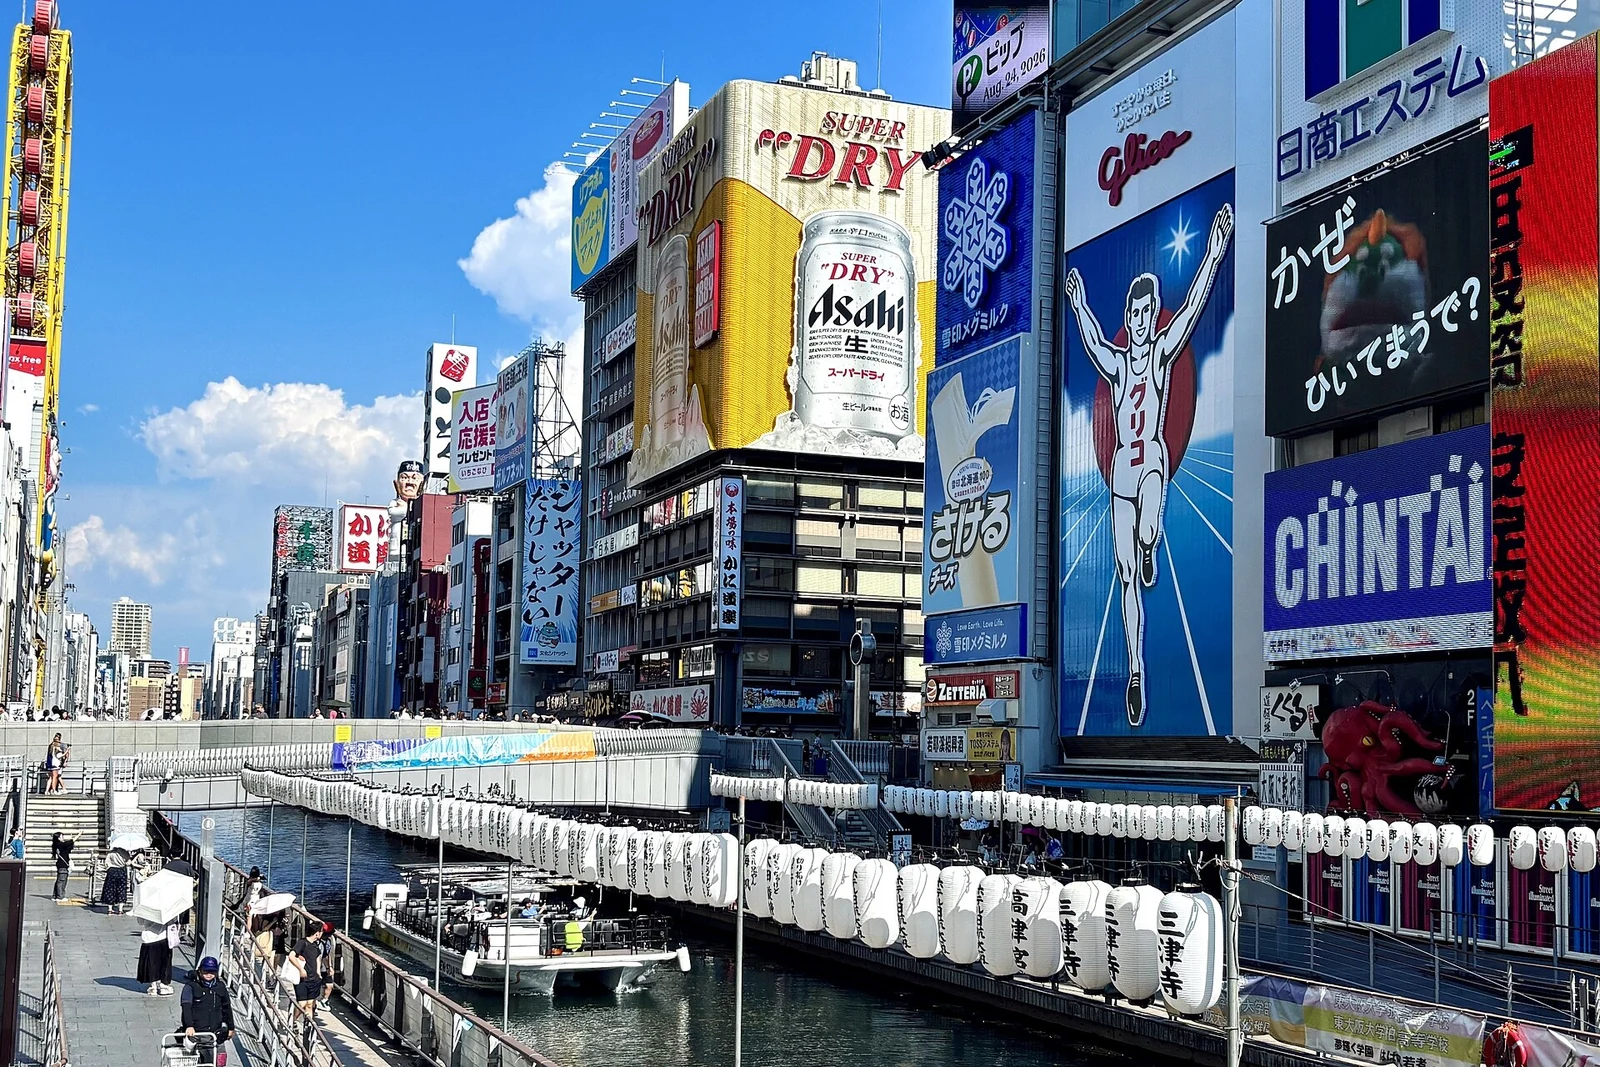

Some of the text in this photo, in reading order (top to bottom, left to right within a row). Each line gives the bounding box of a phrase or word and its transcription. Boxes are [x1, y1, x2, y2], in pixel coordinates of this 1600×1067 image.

[986, 21, 1025, 76] ピップ
[984, 80, 1004, 103] Aug.
[1020, 47, 1046, 76] 2026
[820, 110, 907, 140] SUPER
[1276, 44, 1487, 182] 日商エステム
[661, 125, 695, 177] SUPER
[1098, 130, 1192, 207] Glico
[841, 252, 877, 264] SUPER
[1271, 195, 1357, 310] かぜ
[808, 284, 903, 335] Asahi
[942, 302, 1009, 349] 雪印メグミルク
[22, 355, 42, 364] Free
[844, 335, 868, 354] 生
[828, 368, 885, 382] スーパードライ
[1129, 376, 1148, 467] グリコ
[547, 482, 580, 617] シャッター
[725, 501, 738, 551] 本場の味
[930, 489, 1011, 562] さける
[1275, 455, 1485, 609] CHINTAI
[522, 484, 550, 625] だけじゃない
[928, 562, 959, 595] チーズ
[954, 632, 1008, 653] 雪印メグミルク
[938, 682, 987, 701] ZETTERIA
[1271, 692, 1308, 732] くくる
[1059, 898, 1081, 977] 三津寺
[1158, 911, 1185, 1000] 三津寺
[1335, 1038, 1375, 1059] 夢輝く学園
